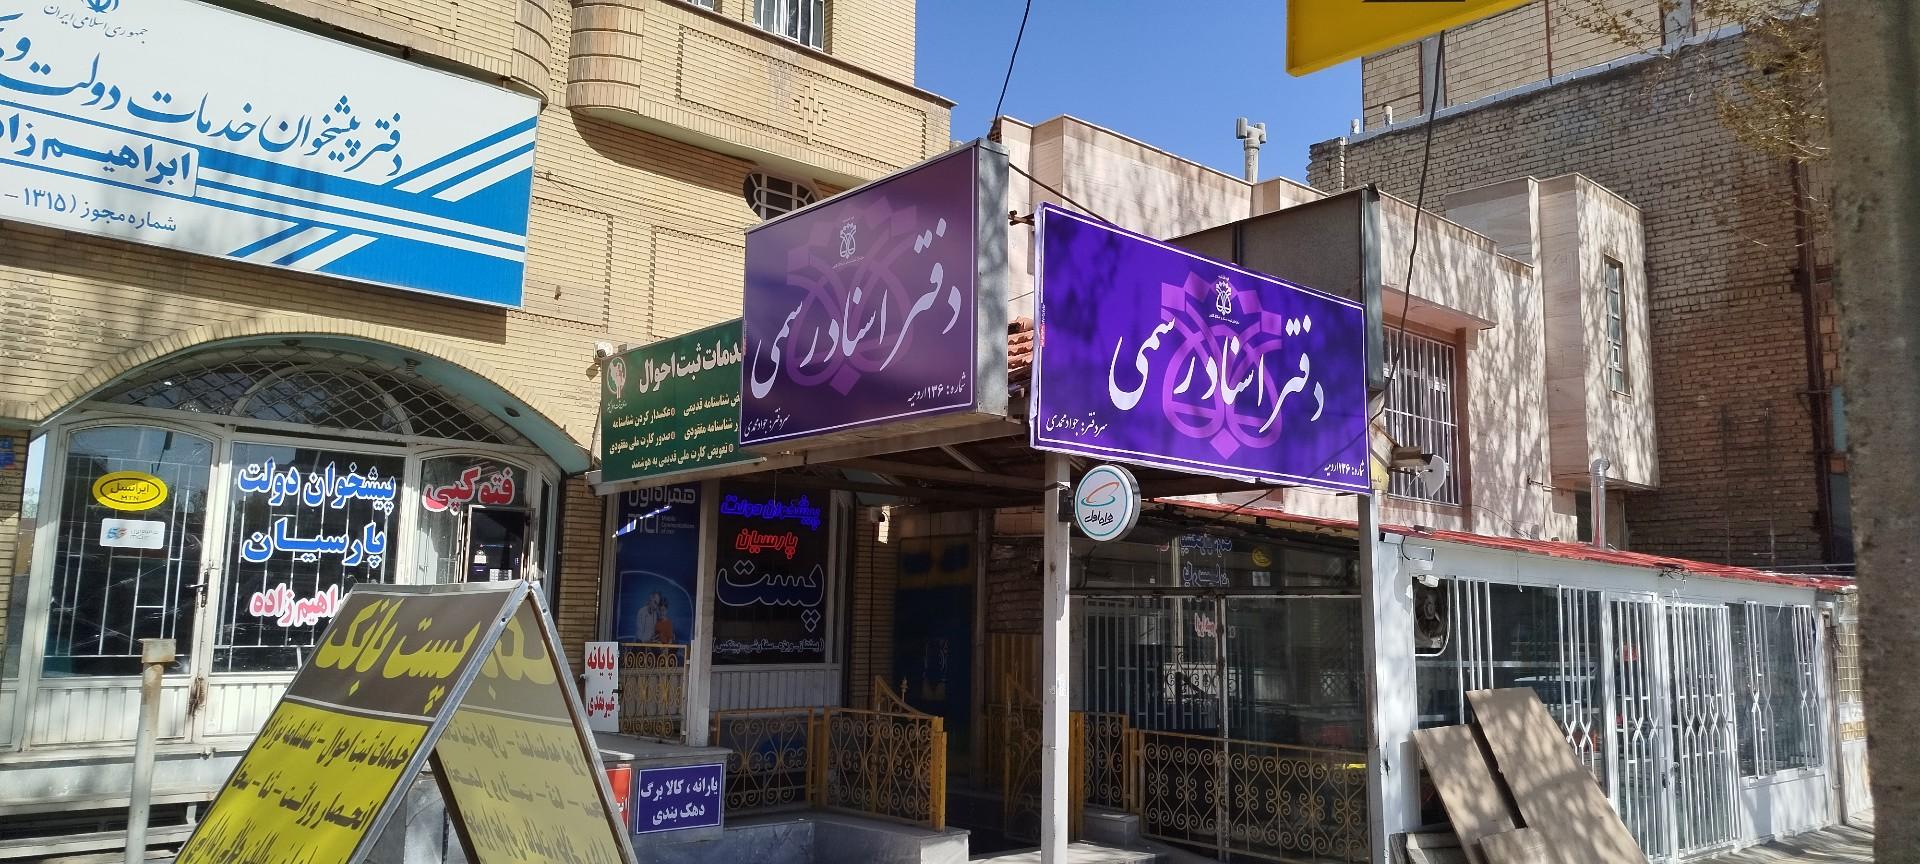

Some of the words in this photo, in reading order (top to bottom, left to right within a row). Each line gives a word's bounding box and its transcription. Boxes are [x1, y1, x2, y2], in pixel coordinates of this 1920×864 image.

[43, 4, 74, 25] ایران
[72, 17, 108, 30] اسلامی
[104, 26, 149, 44] جمهوری
[0, 52, 121, 110] دولت
[127, 91, 258, 143] خدمات
[258, 95, 362, 162] پیشخوان
[351, 112, 403, 177] دفتر
[42, 137, 190, 186] ابراهیم
[80, 201, 126, 224] مجوز
[128, 212, 177, 232] شماره
[880, 218, 962, 371] دفتر
[824, 286, 888, 363] اسناد
[751, 301, 819, 399] رسمی
[677, 342, 702, 381] ثبت
[1108, 317, 1196, 411] رسمی
[1201, 335, 1265, 407] اسناد
[639, 352, 676, 394] احوال
[1258, 314, 1324, 433] دفتر
[704, 392, 730, 408] شناسنامه
[928, 384, 944, 399] ۱۳۶
[683, 397, 703, 417] قدیمی
[612, 414, 634, 428] شناسنامه
[634, 410, 650, 427] کردن
[707, 417, 733, 433] شناسنامه
[1045, 413, 1067, 432] محمدی
[1064, 418, 1080, 437] جواد
[640, 432, 655, 449] کارت
[655, 432, 671, 447] صدور
[684, 423, 707, 441] مفقودی
[609, 439, 629, 455] مفقودی
[628, 435, 640, 451] ملی
[690, 445, 706, 462] کارت
[707, 442, 728, 460] تعویض
[631, 456, 651, 471] هوشمند
[651, 457, 658, 468] به
[658, 449, 677, 467] قدیمی
[677, 449, 690, 464] ملی
[110, 482, 150, 494] ایرانسل
[238, 456, 300, 507] دولت
[303, 462, 397, 515] پیشخوان
[1084, 509, 1101, 523] اول
[1099, 511, 1114, 526] همراه
[242, 517, 386, 568] پارسیان
[735, 528, 799, 560] پارسیان
[250, 583, 296, 627] زاده
[716, 559, 825, 633] پست
[315, 598, 405, 696] بانک
[383, 617, 481, 715] پست
[587, 646, 615, 680] پایانه
[283, 719, 323, 750] شناسنامه
[316, 726, 362, 767] احوال
[348, 729, 382, 771] ثبت
[368, 736, 416, 770] خدمات
[640, 782, 664, 802] برگ
[666, 779, 684, 796] کالا
[692, 776, 718, 797] یارانه
[279, 781, 321, 827] وراثت
[309, 791, 380, 831] انحصار
[680, 802, 706, 818] دهک
[652, 806, 678, 826] بندی
